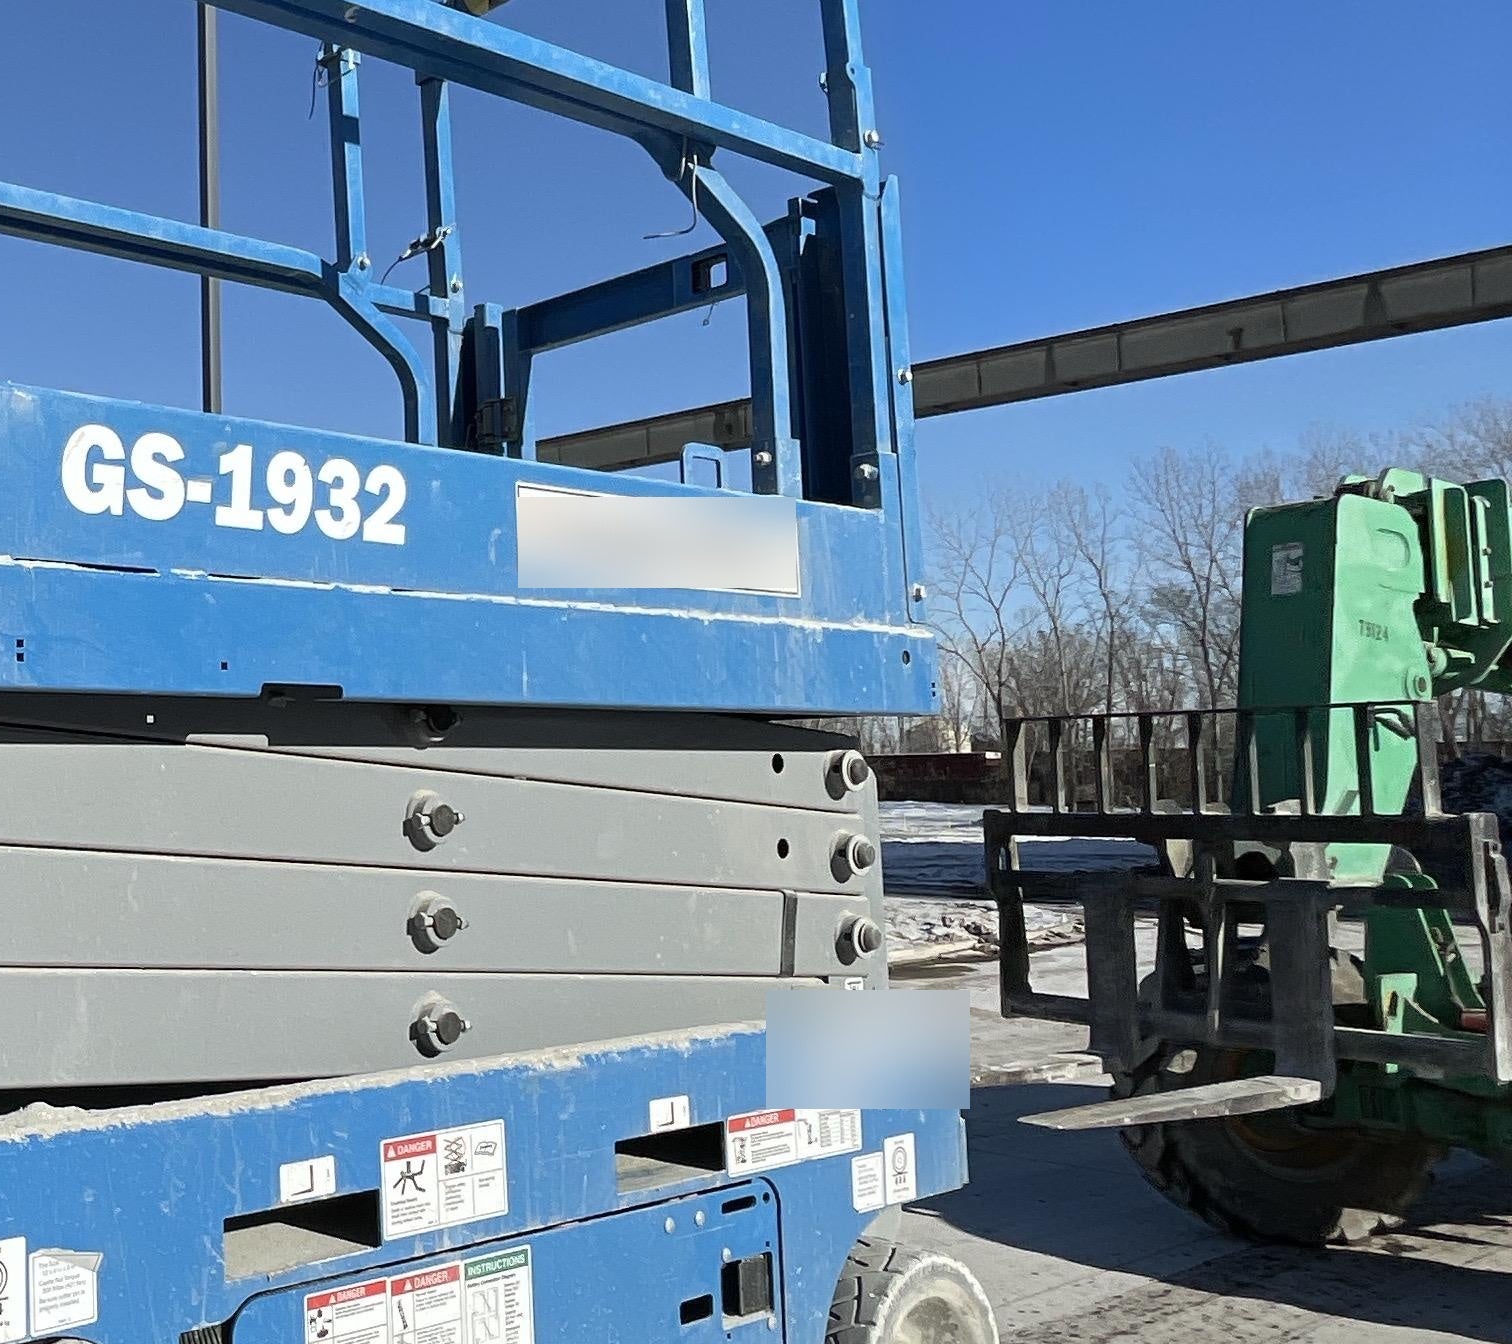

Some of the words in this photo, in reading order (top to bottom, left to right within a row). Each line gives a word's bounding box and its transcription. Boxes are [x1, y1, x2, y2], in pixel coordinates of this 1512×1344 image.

[61, 423, 407, 546] GS-1932
[750, 1112, 780, 1128] DANGER
[397, 1140, 433, 1155] DANGER
[467, 1253, 525, 1276] INSTRUCTIONS
[414, 1270, 448, 1288] DANGER
